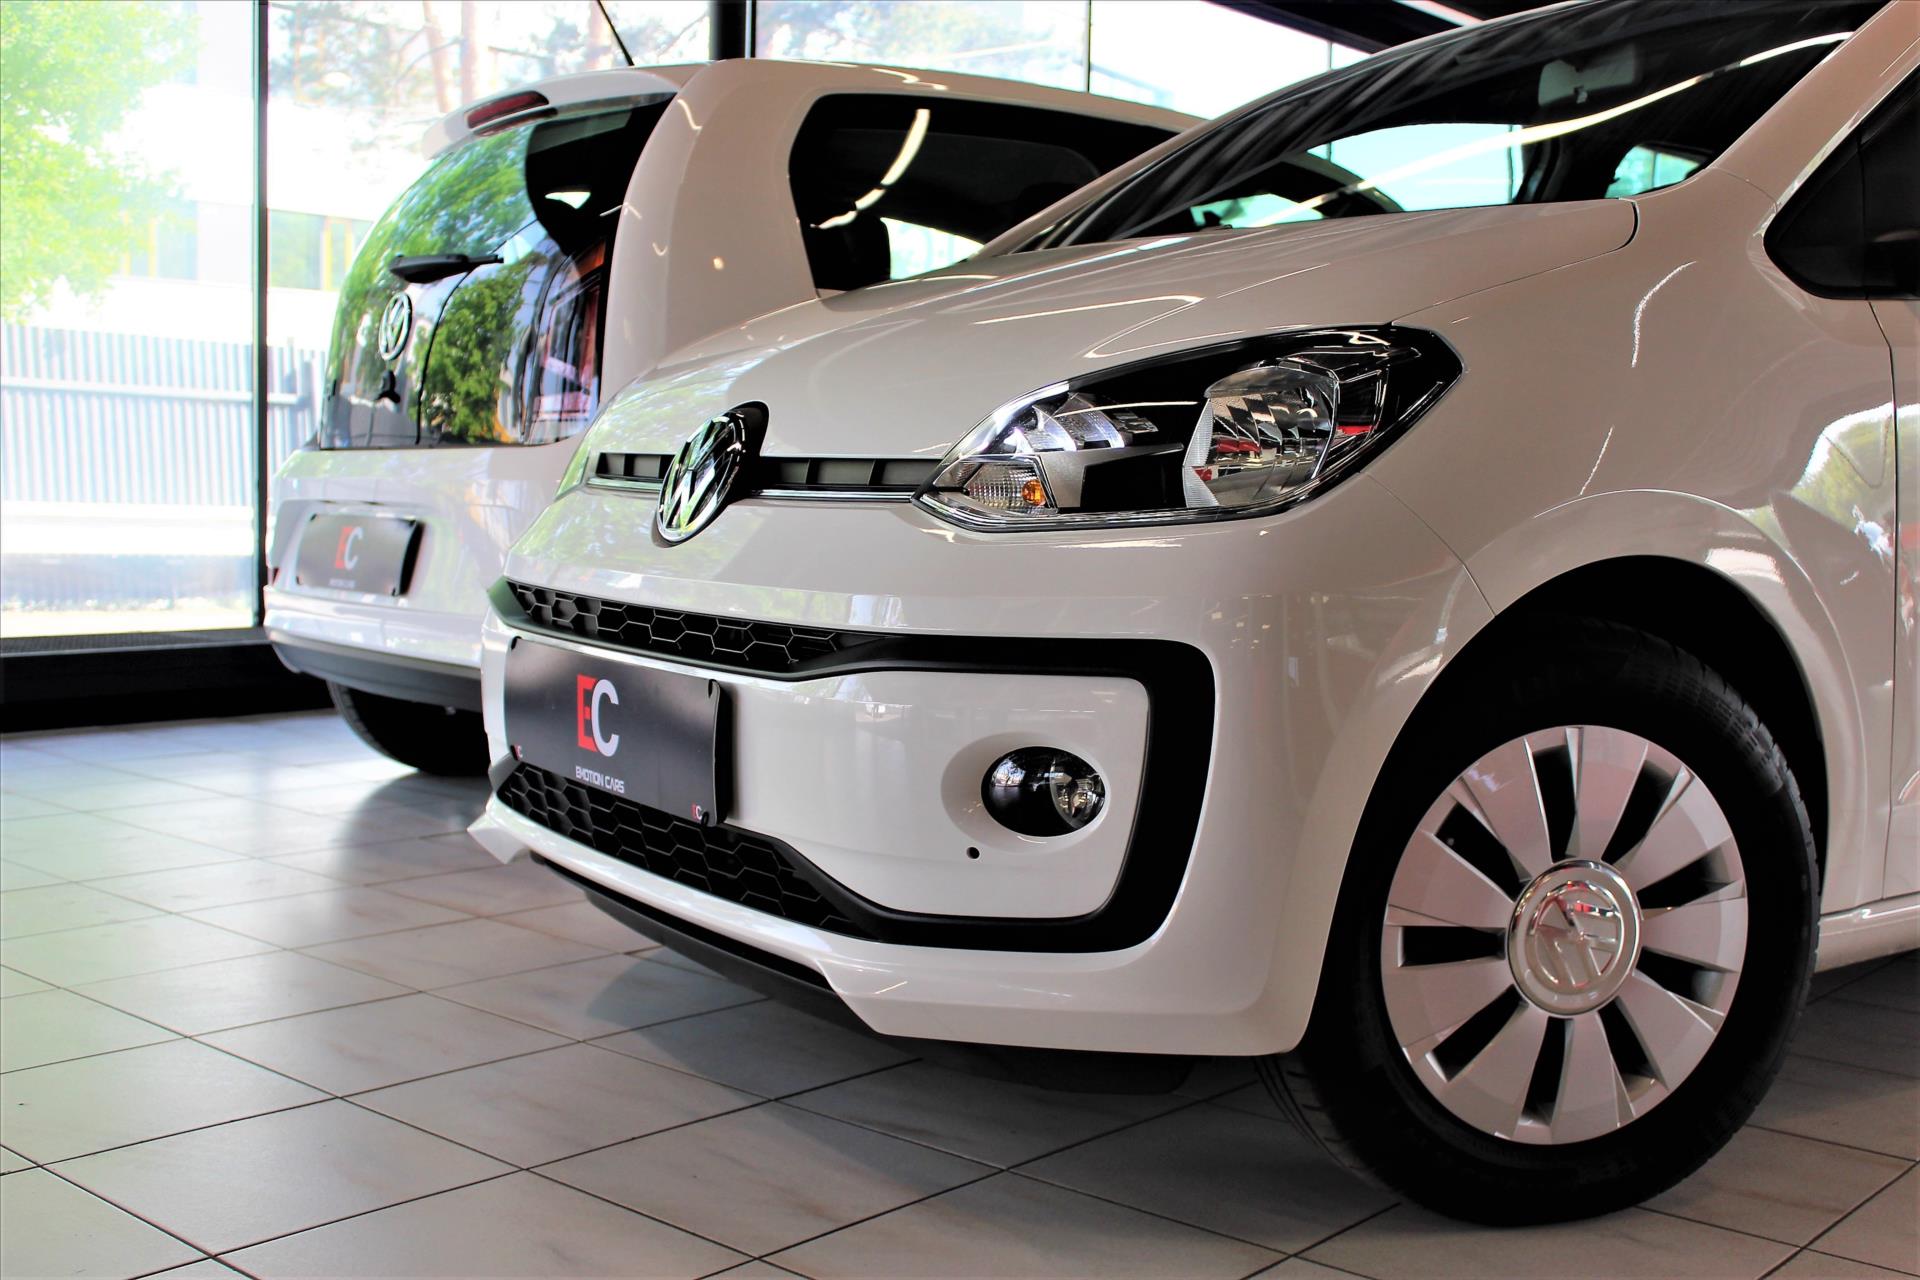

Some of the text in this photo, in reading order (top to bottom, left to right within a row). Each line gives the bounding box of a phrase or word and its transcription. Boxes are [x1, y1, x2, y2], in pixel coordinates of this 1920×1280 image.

[577, 674, 620, 757] EC
[575, 765, 625, 793] EMOTION CARS
